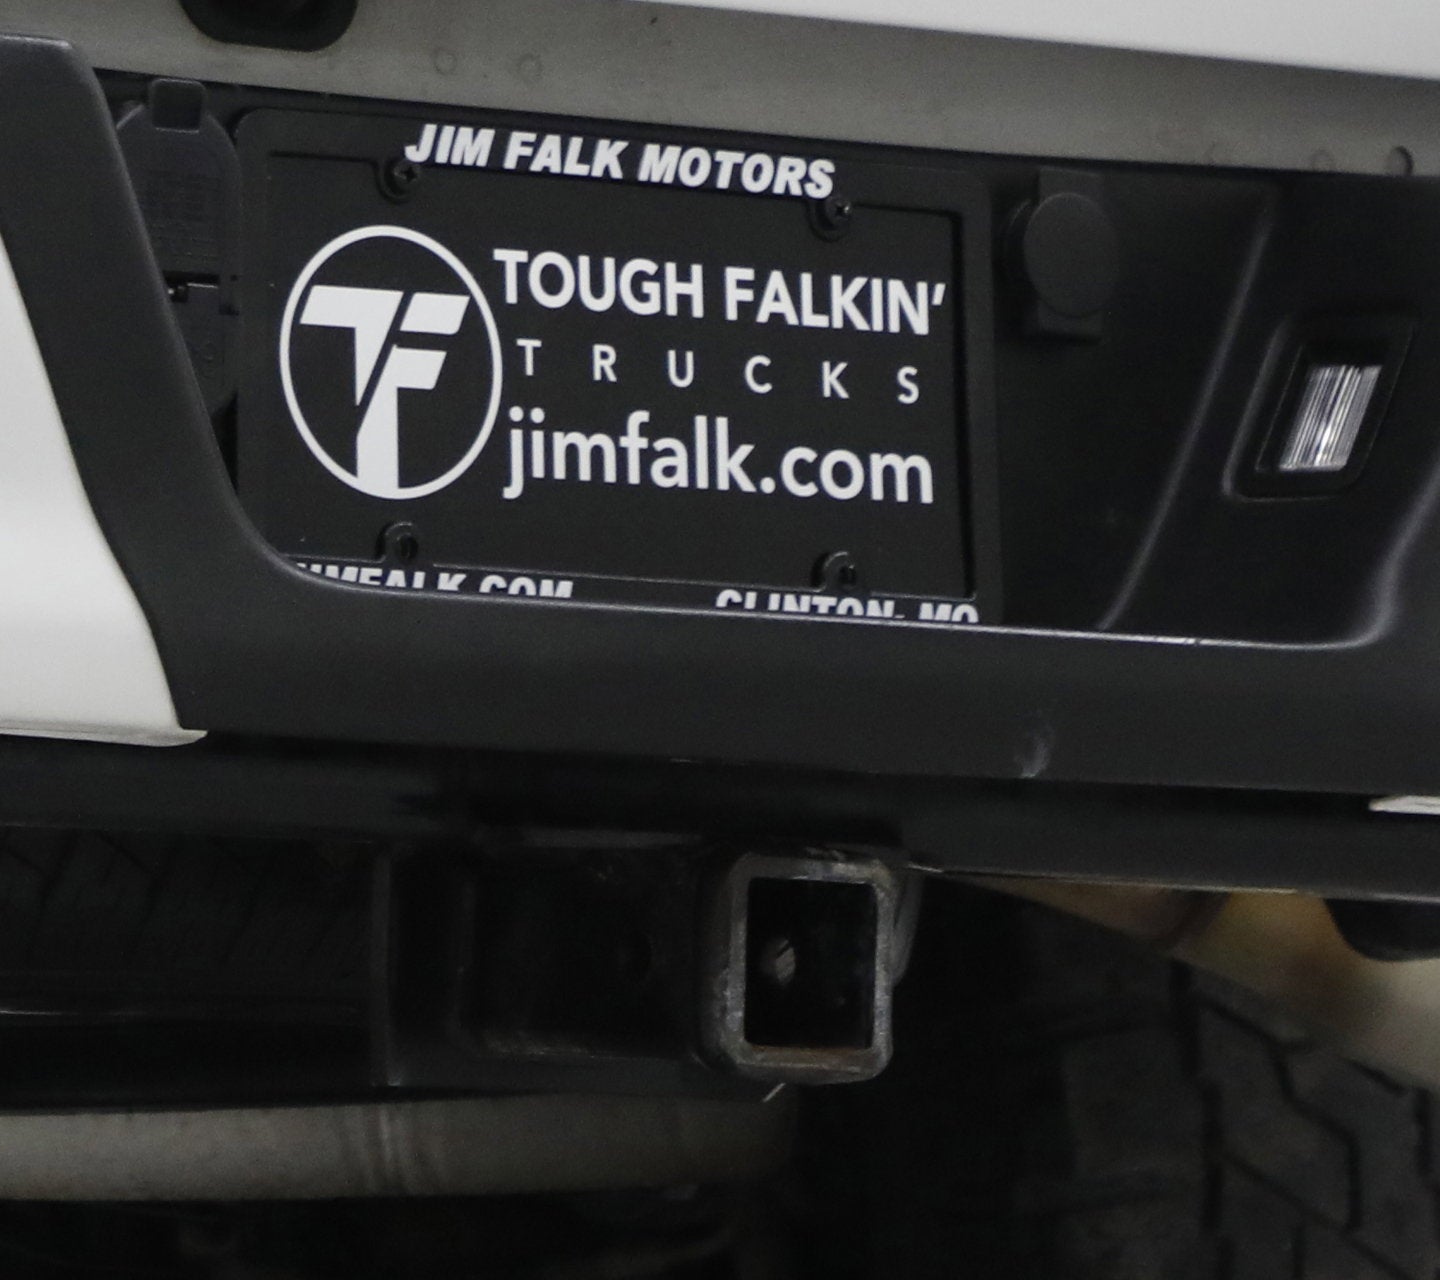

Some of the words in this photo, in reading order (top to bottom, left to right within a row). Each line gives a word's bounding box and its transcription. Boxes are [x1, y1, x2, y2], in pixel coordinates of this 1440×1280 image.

[404, 123, 496, 167] JIM
[502, 131, 630, 180] FALK
[637, 144, 836, 200] MOTORS
[491, 247, 705, 319] TOUGH
[723, 265, 946, 336] FALKIN'
[516, 337, 921, 405] TRUCKS
[502, 406, 934, 504] jimfalk.com
